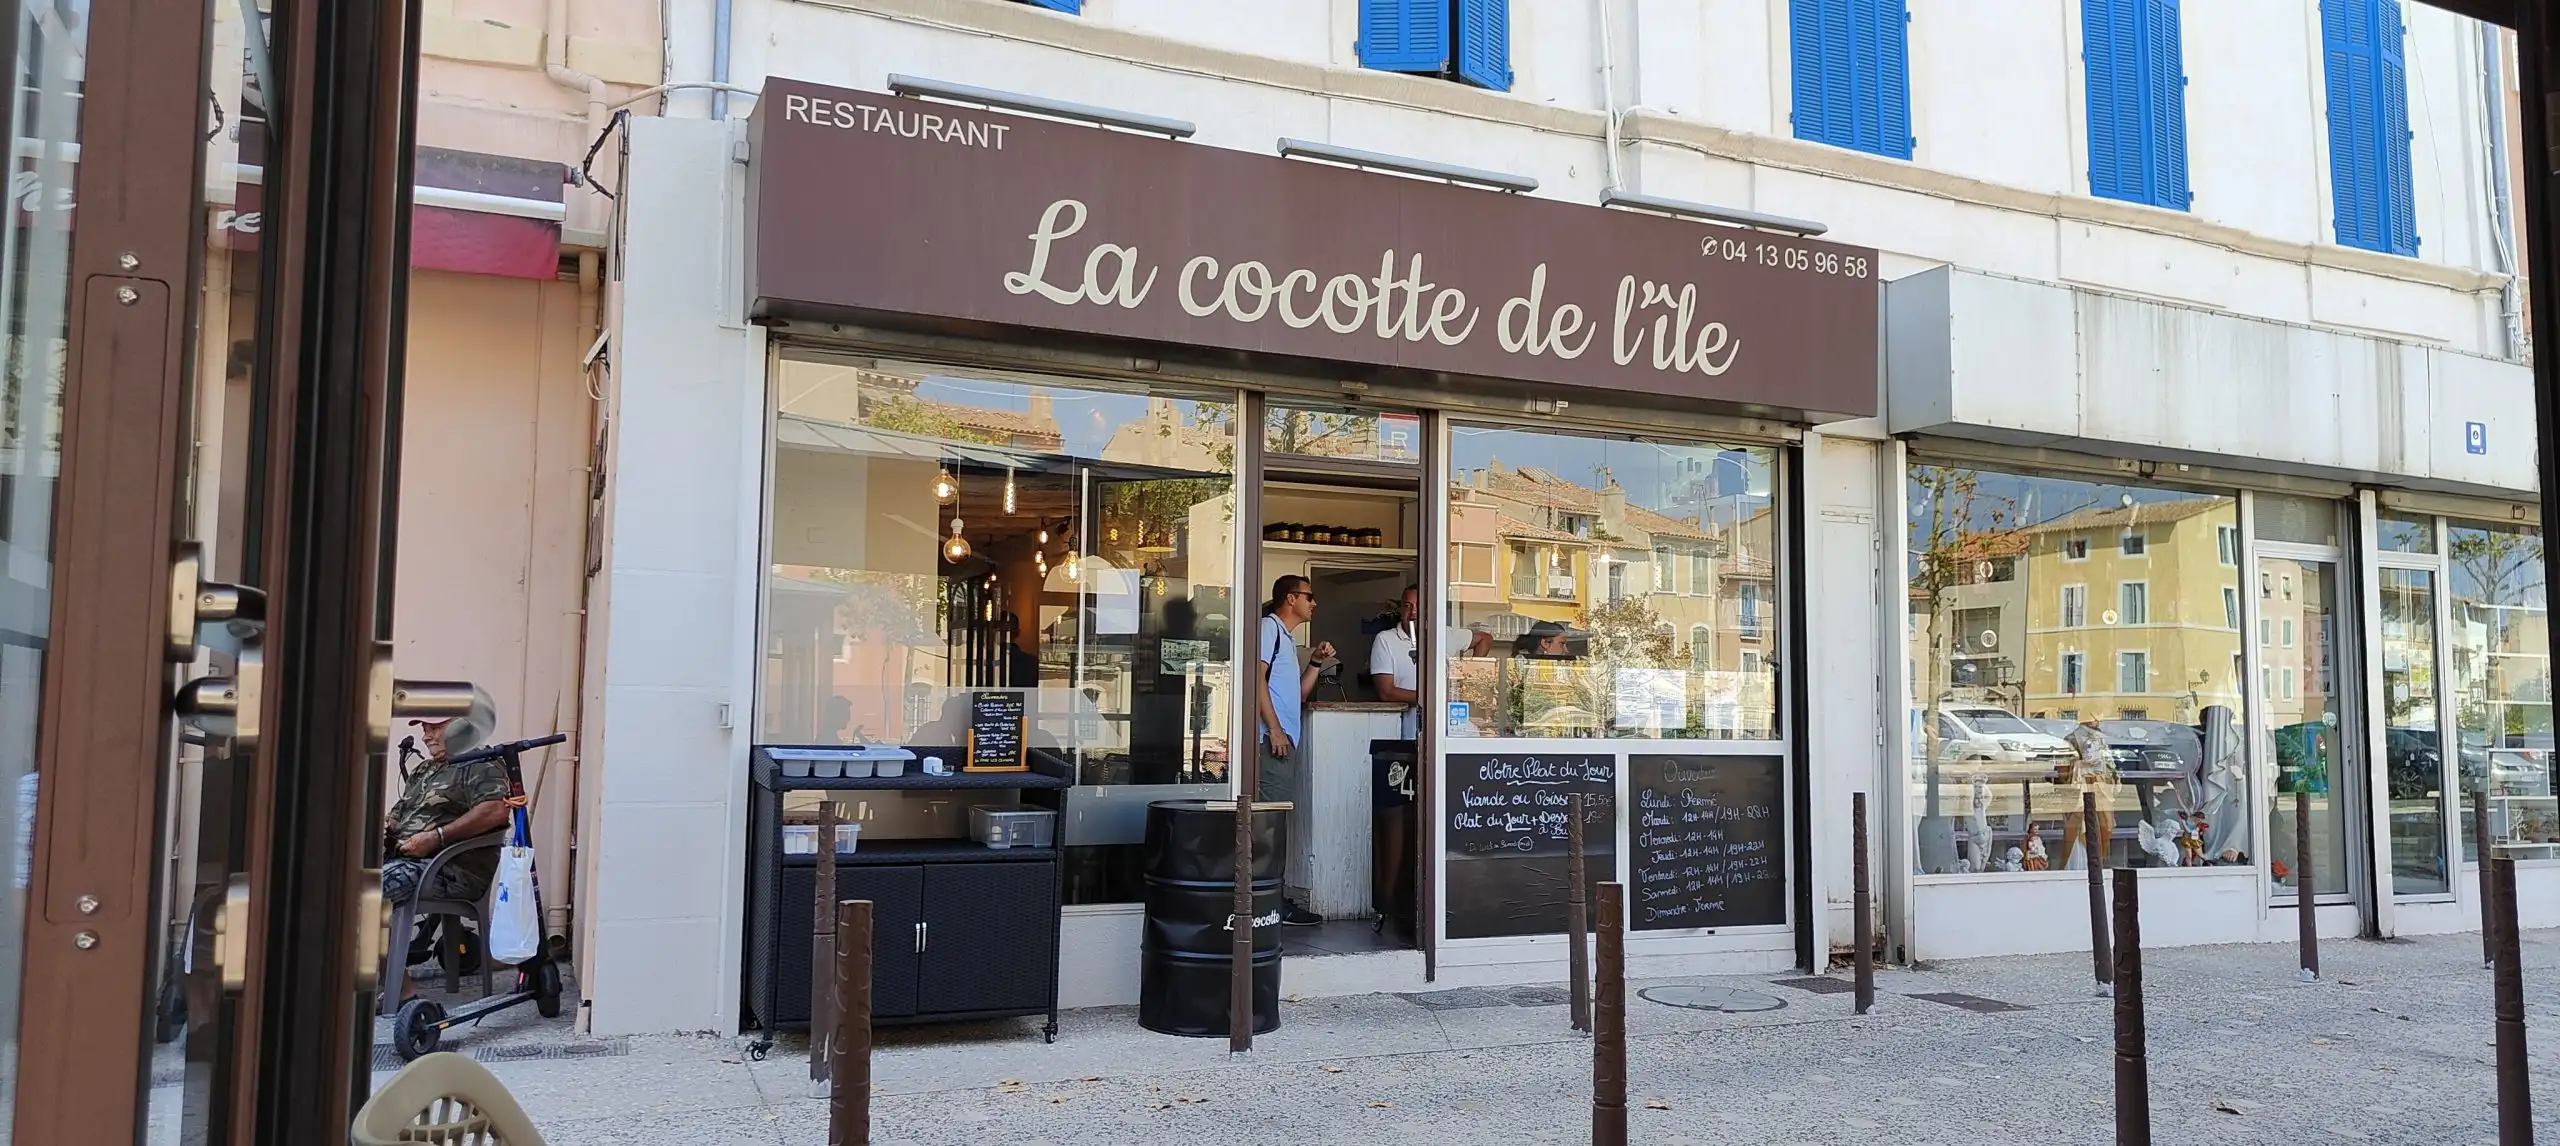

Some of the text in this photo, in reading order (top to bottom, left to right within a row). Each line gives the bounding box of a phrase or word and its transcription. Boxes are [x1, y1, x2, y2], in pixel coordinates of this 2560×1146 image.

[785, 94, 1010, 150] RESTAURANT
[1722, 239, 1868, 279] 04 13 05 96 58
[1004, 199, 1158, 309] La
[1178, 249, 1480, 346] cocotte
[1498, 263, 1597, 360] de
[1480, 757, 1613, 780] Notre Plat du Jour
[1463, 786, 1508, 808] Viande
[1512, 795, 1531, 805] ou
[1535, 789, 1568, 806] Poiss
[1454, 813, 1483, 830] Plat
[1487, 813, 1504, 827] du
[1503, 813, 1531, 832] Jour
[1251, 909, 1280, 928] ocotte
